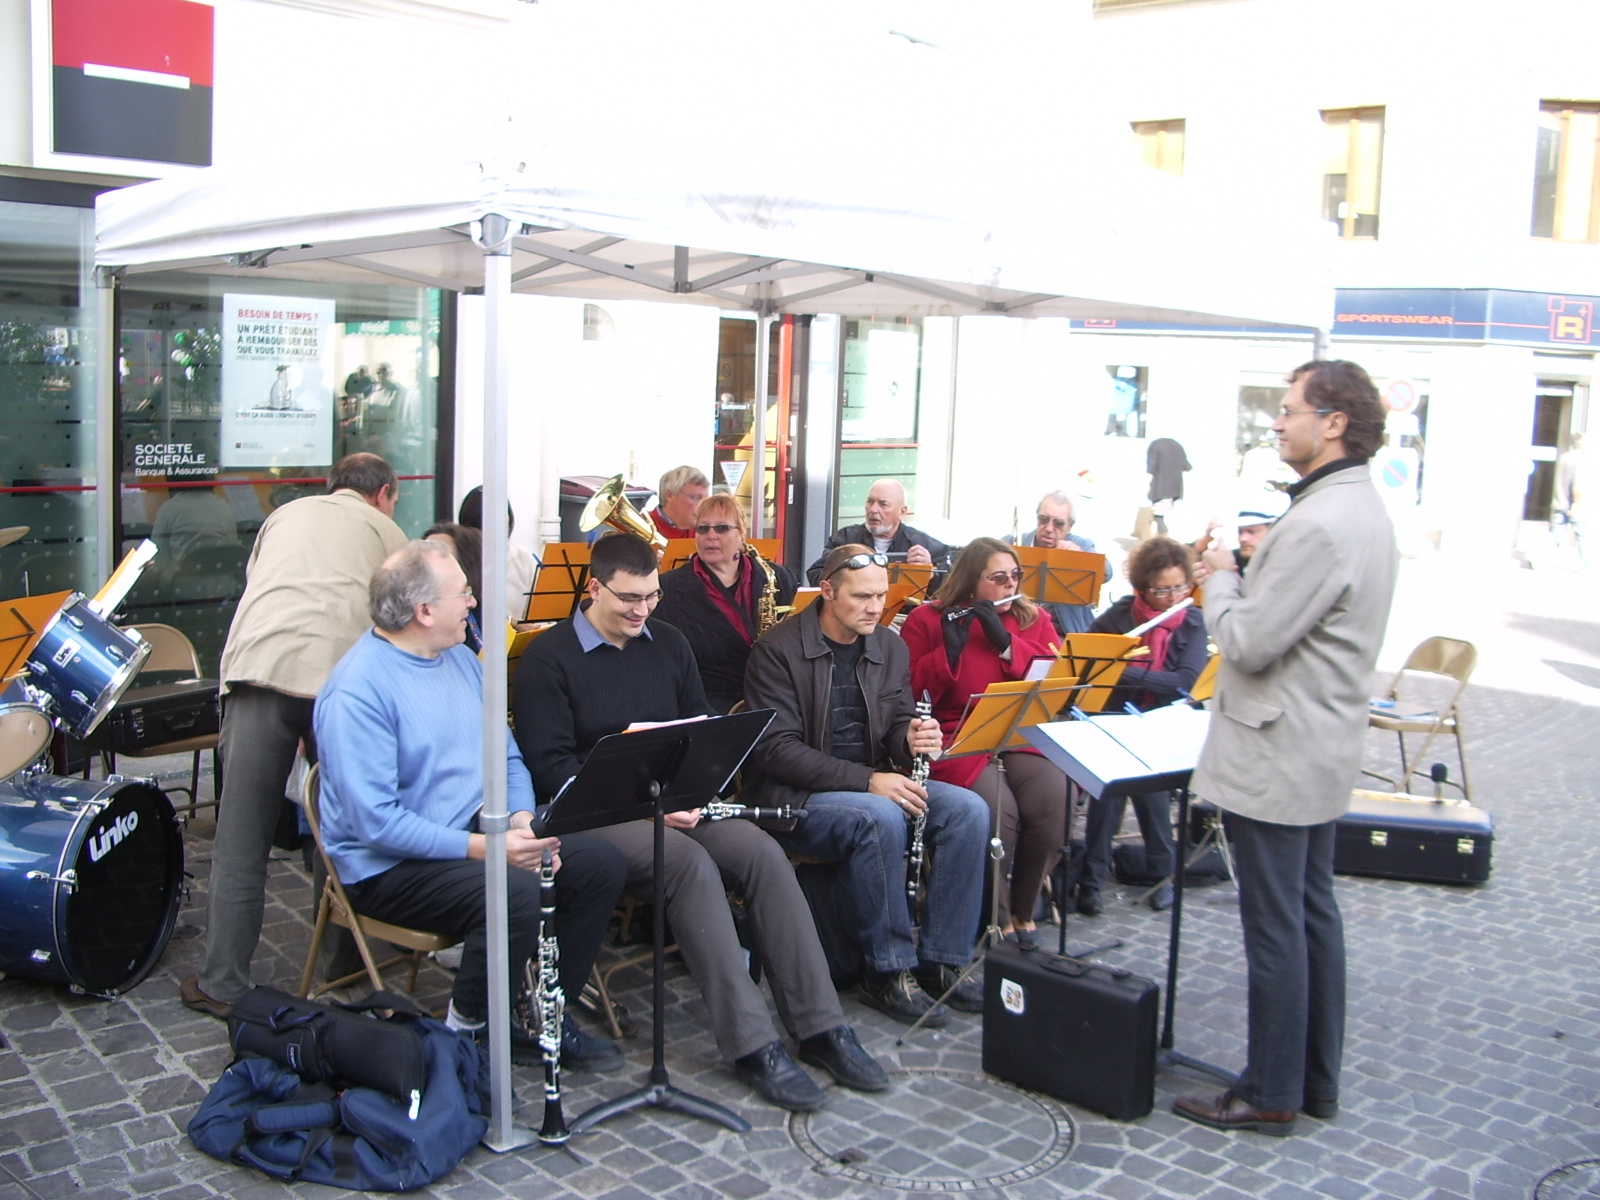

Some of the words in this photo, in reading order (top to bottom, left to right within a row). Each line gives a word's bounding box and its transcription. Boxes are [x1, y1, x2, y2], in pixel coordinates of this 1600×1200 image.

[238, 308, 271, 319] BESOIN
[272, 310, 284, 320] DE
[286, 311, 312, 321] TEMPS
[1336, 313, 1454, 326] SPORTSWEAR
[237, 324, 250, 334] UN
[254, 346, 275, 355] VOUS
[135, 443, 193, 454] SOCIETE
[135, 454, 206, 466] GENERALE
[135, 467, 166, 477] Banque
[167, 466, 173, 475] &
[174, 466, 219, 475] Assurances
[89, 811, 139, 862] Linko
